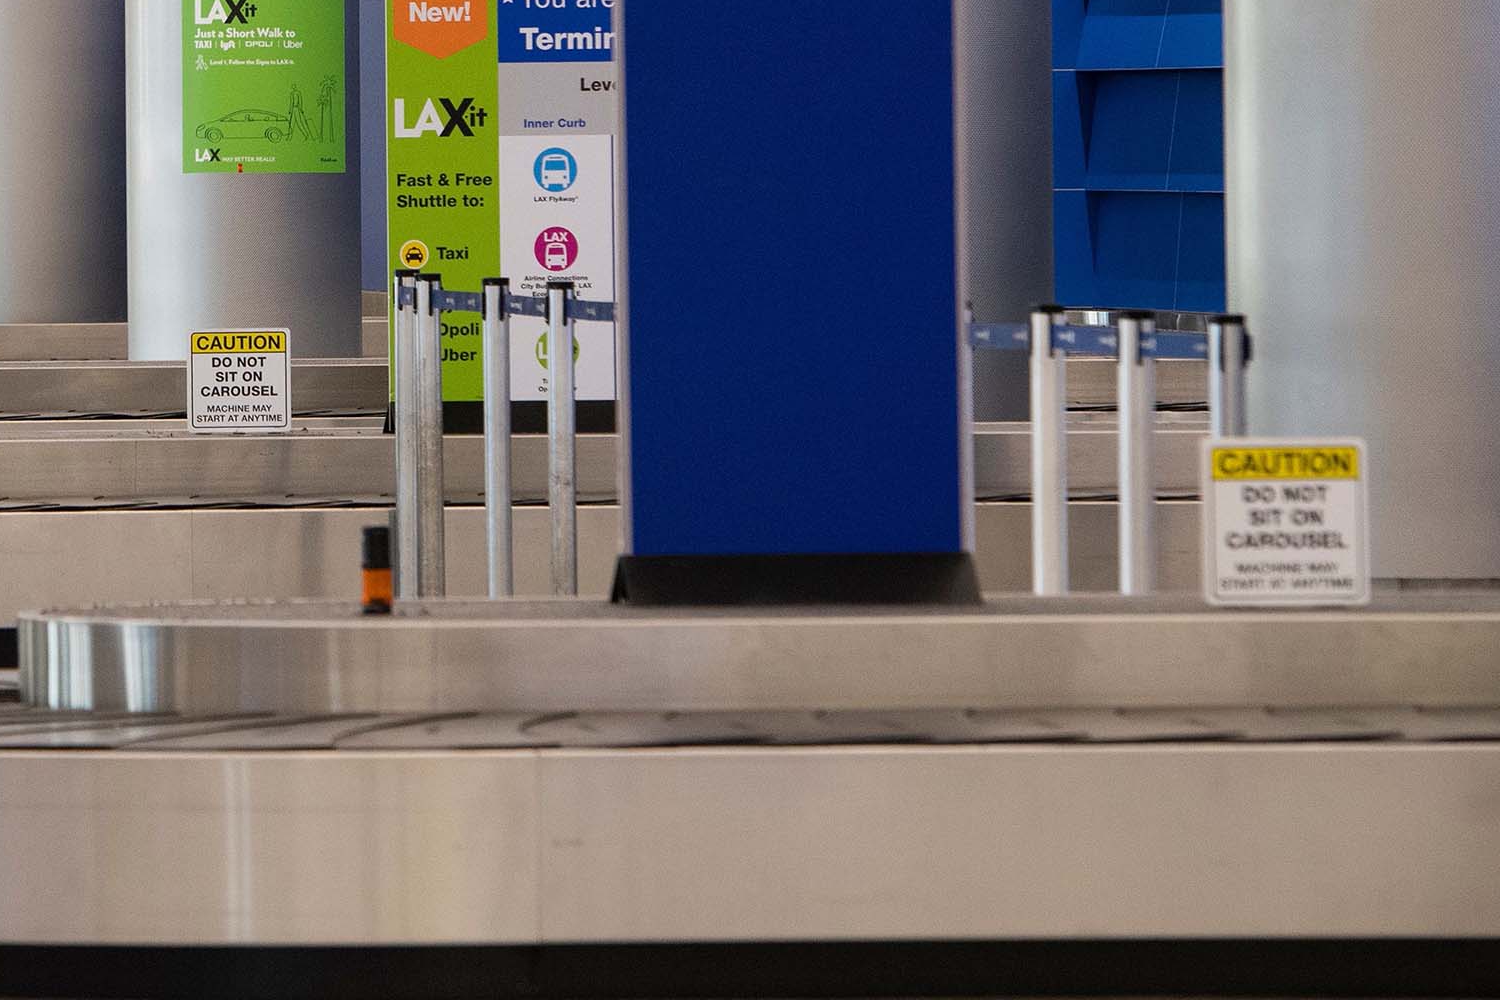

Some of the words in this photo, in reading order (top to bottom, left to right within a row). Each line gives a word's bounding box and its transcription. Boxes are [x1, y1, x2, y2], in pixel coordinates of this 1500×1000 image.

[409, 1, 471, 23] New!
[194, 28, 216, 39] Just
[217, 30, 224, 38] a
[226, 27, 255, 39] Short
[257, 27, 284, 38] Walk
[285, 28, 296, 38] to
[194, 40, 212, 49] TAXI
[283, 40, 304, 49] Uber
[524, 118, 554, 128] Inner
[558, 118, 587, 128] Curb
[194, 148, 221, 163] LAX
[396, 173, 432, 188] Fast
[438, 173, 450, 187] &
[456, 172, 493, 187] Free
[396, 194, 457, 208] Shuttle
[462, 194, 484, 208] to:
[543, 231, 568, 243] LAX
[436, 247, 469, 260] Taxi
[547, 274, 589, 282] Connections
[197, 335, 280, 351] CAUTION
[212, 357, 232, 368] DO
[237, 357, 267, 368] NOT
[215, 371, 238, 382] SIT
[243, 371, 263, 382] ON
[201, 386, 278, 397] CAROUSEL
[207, 405, 250, 413] MACHINE
[242, 414, 283, 422] ANYTIME
[1218, 452, 1350, 475] CAUTION
[1243, 486, 1276, 503] DO
[1282, 485, 1328, 502] NOT
[1250, 509, 1282, 526] SIT
[1291, 508, 1324, 525] ON
[1225, 531, 1347, 549] CAROUSEL
